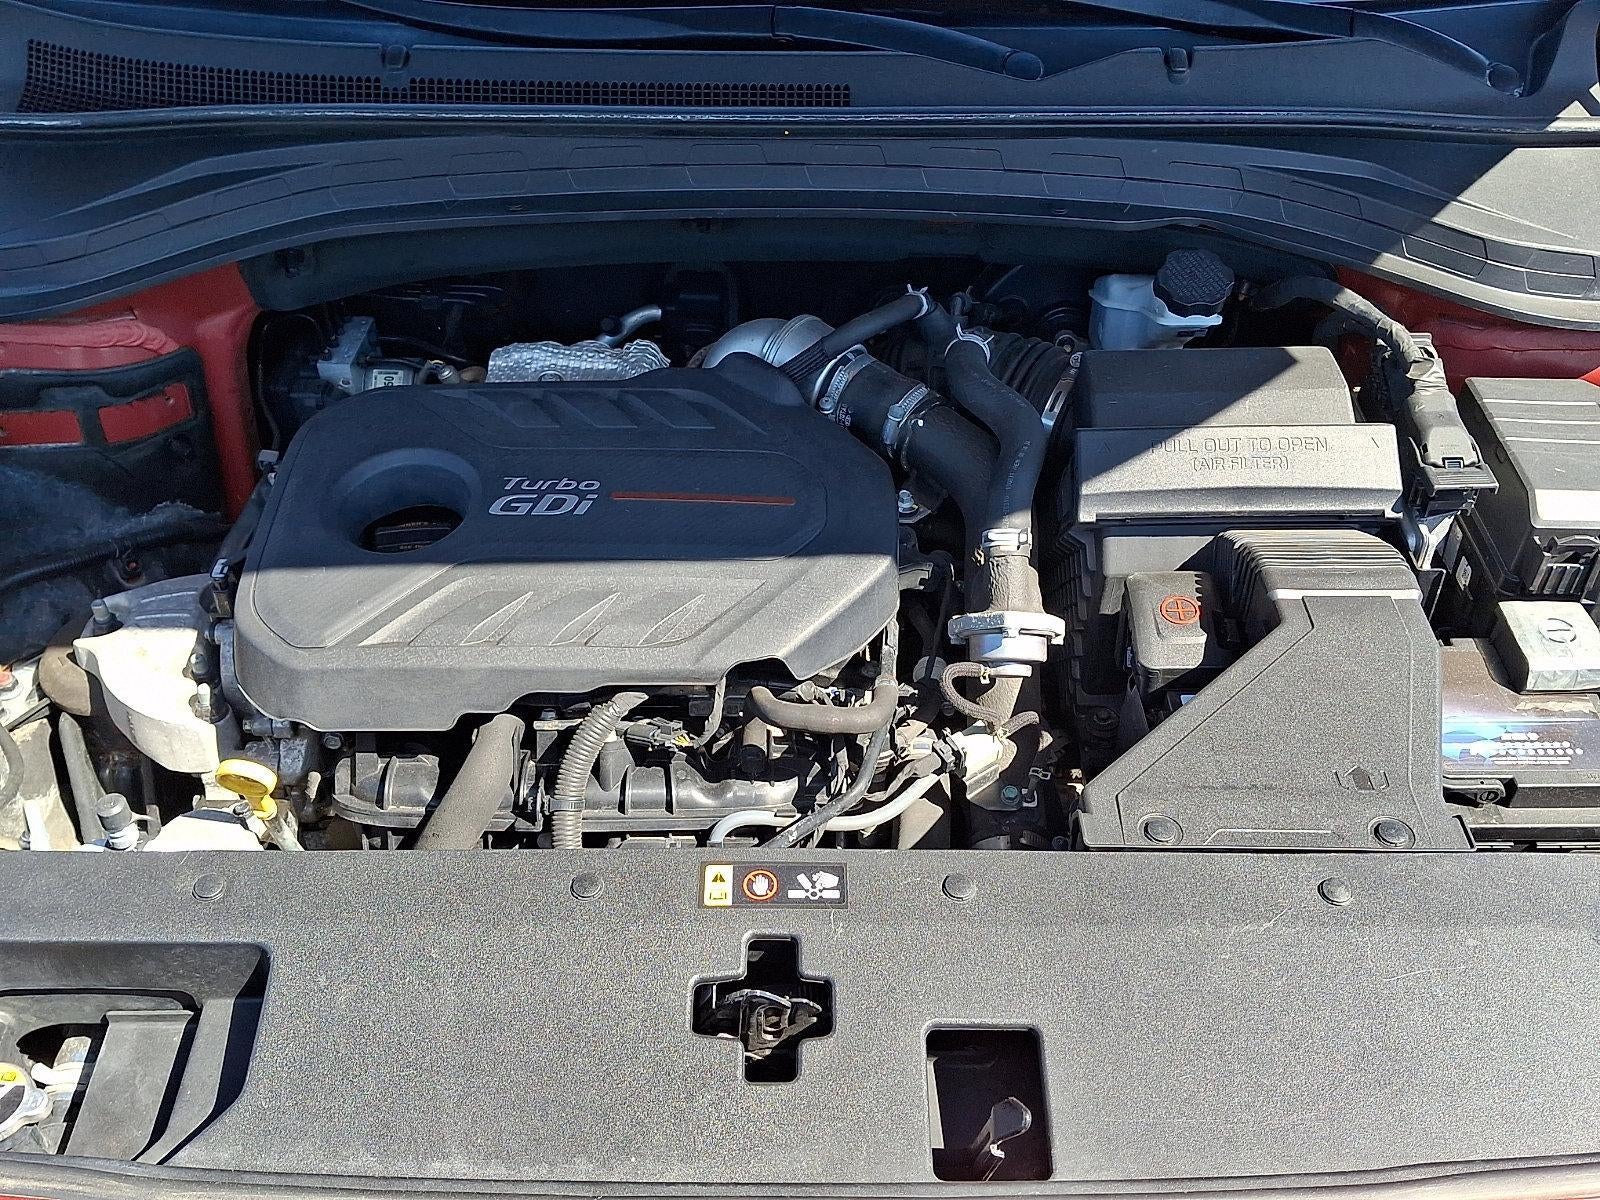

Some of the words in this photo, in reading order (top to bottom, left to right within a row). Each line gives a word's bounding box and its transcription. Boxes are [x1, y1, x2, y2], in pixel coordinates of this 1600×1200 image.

[1151, 438, 1198, 454] PULL
[1204, 437, 1241, 453] OUT
[1248, 437, 1271, 452] TO
[1278, 436, 1328, 452] OPEN
[1193, 456, 1226, 472] (AIR
[1230, 455, 1289, 471] FILTER)
[503, 477, 601, 491] Turbo
[488, 493, 599, 516] GDi
